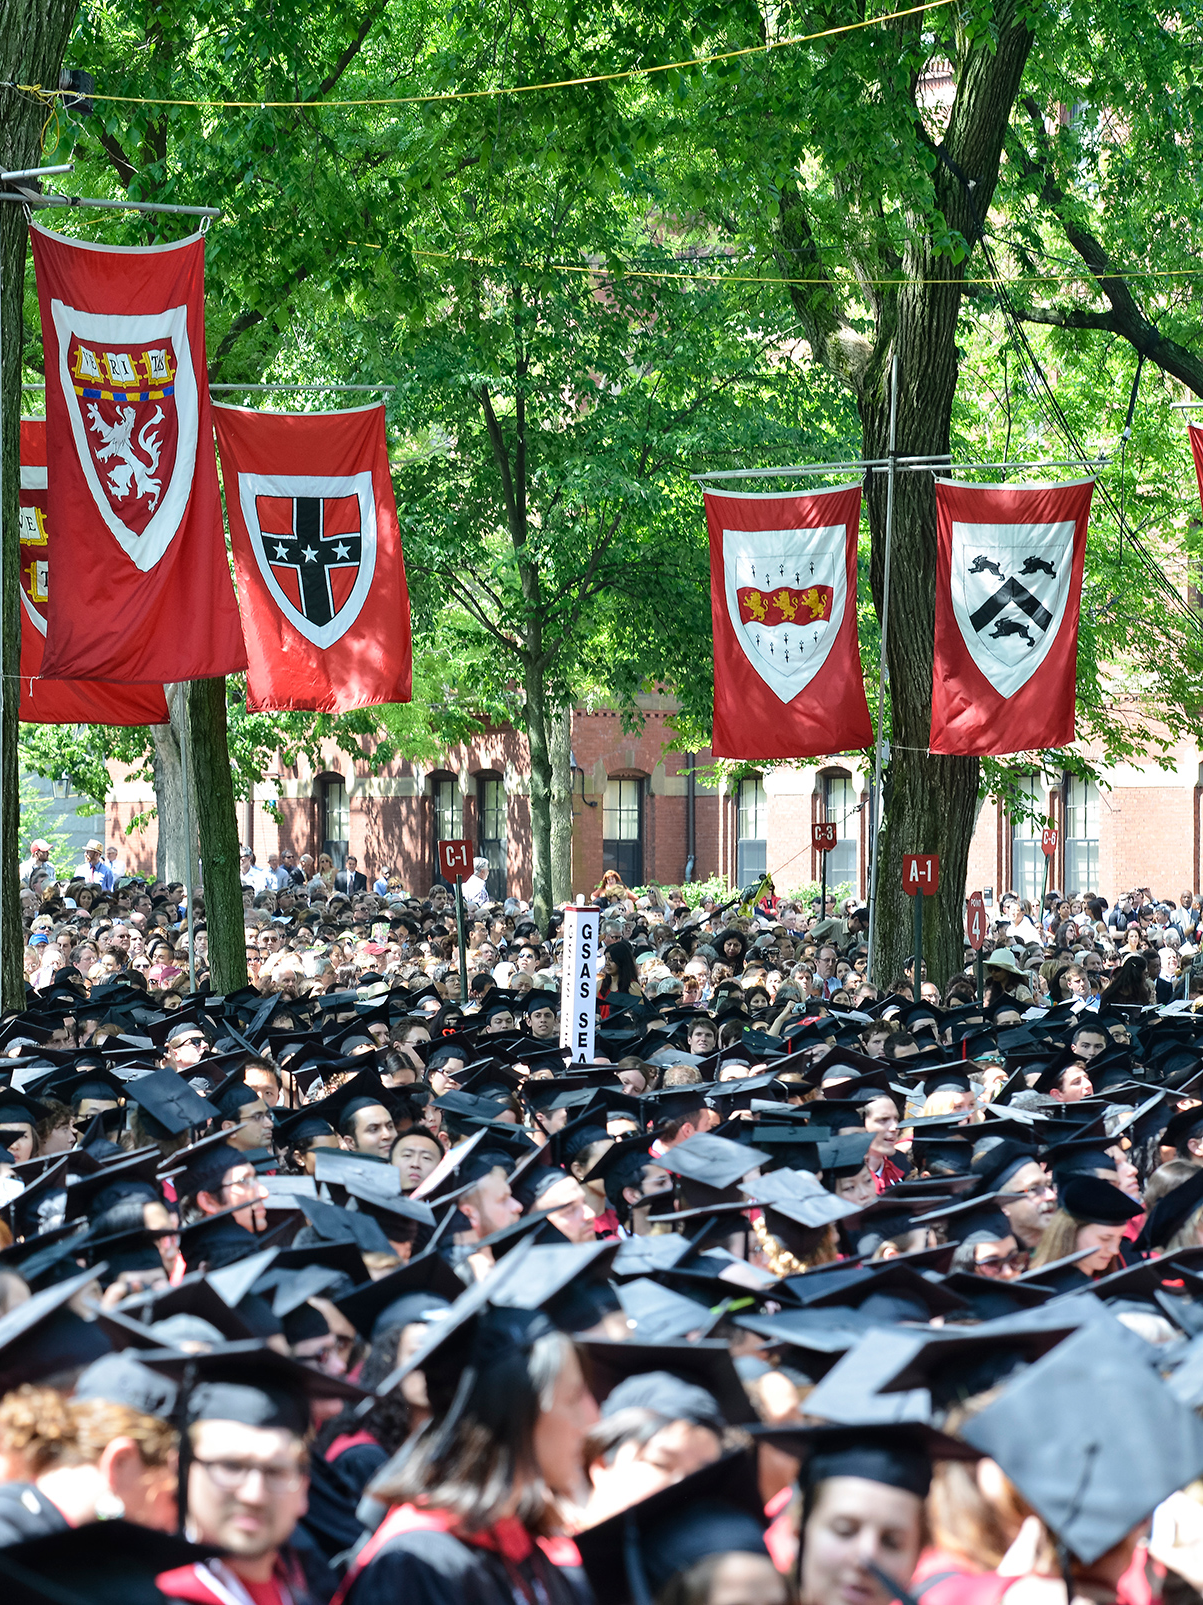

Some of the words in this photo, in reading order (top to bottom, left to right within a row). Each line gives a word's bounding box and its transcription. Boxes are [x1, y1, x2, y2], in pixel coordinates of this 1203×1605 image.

[815, 825, 833, 840] C-3
[1043, 831, 1056, 845] C-6
[446, 845, 467, 867] C-1
[909, 860, 932, 882] A-1
[972, 911, 980, 940] 4
[580, 924, 592, 998] GSAS
